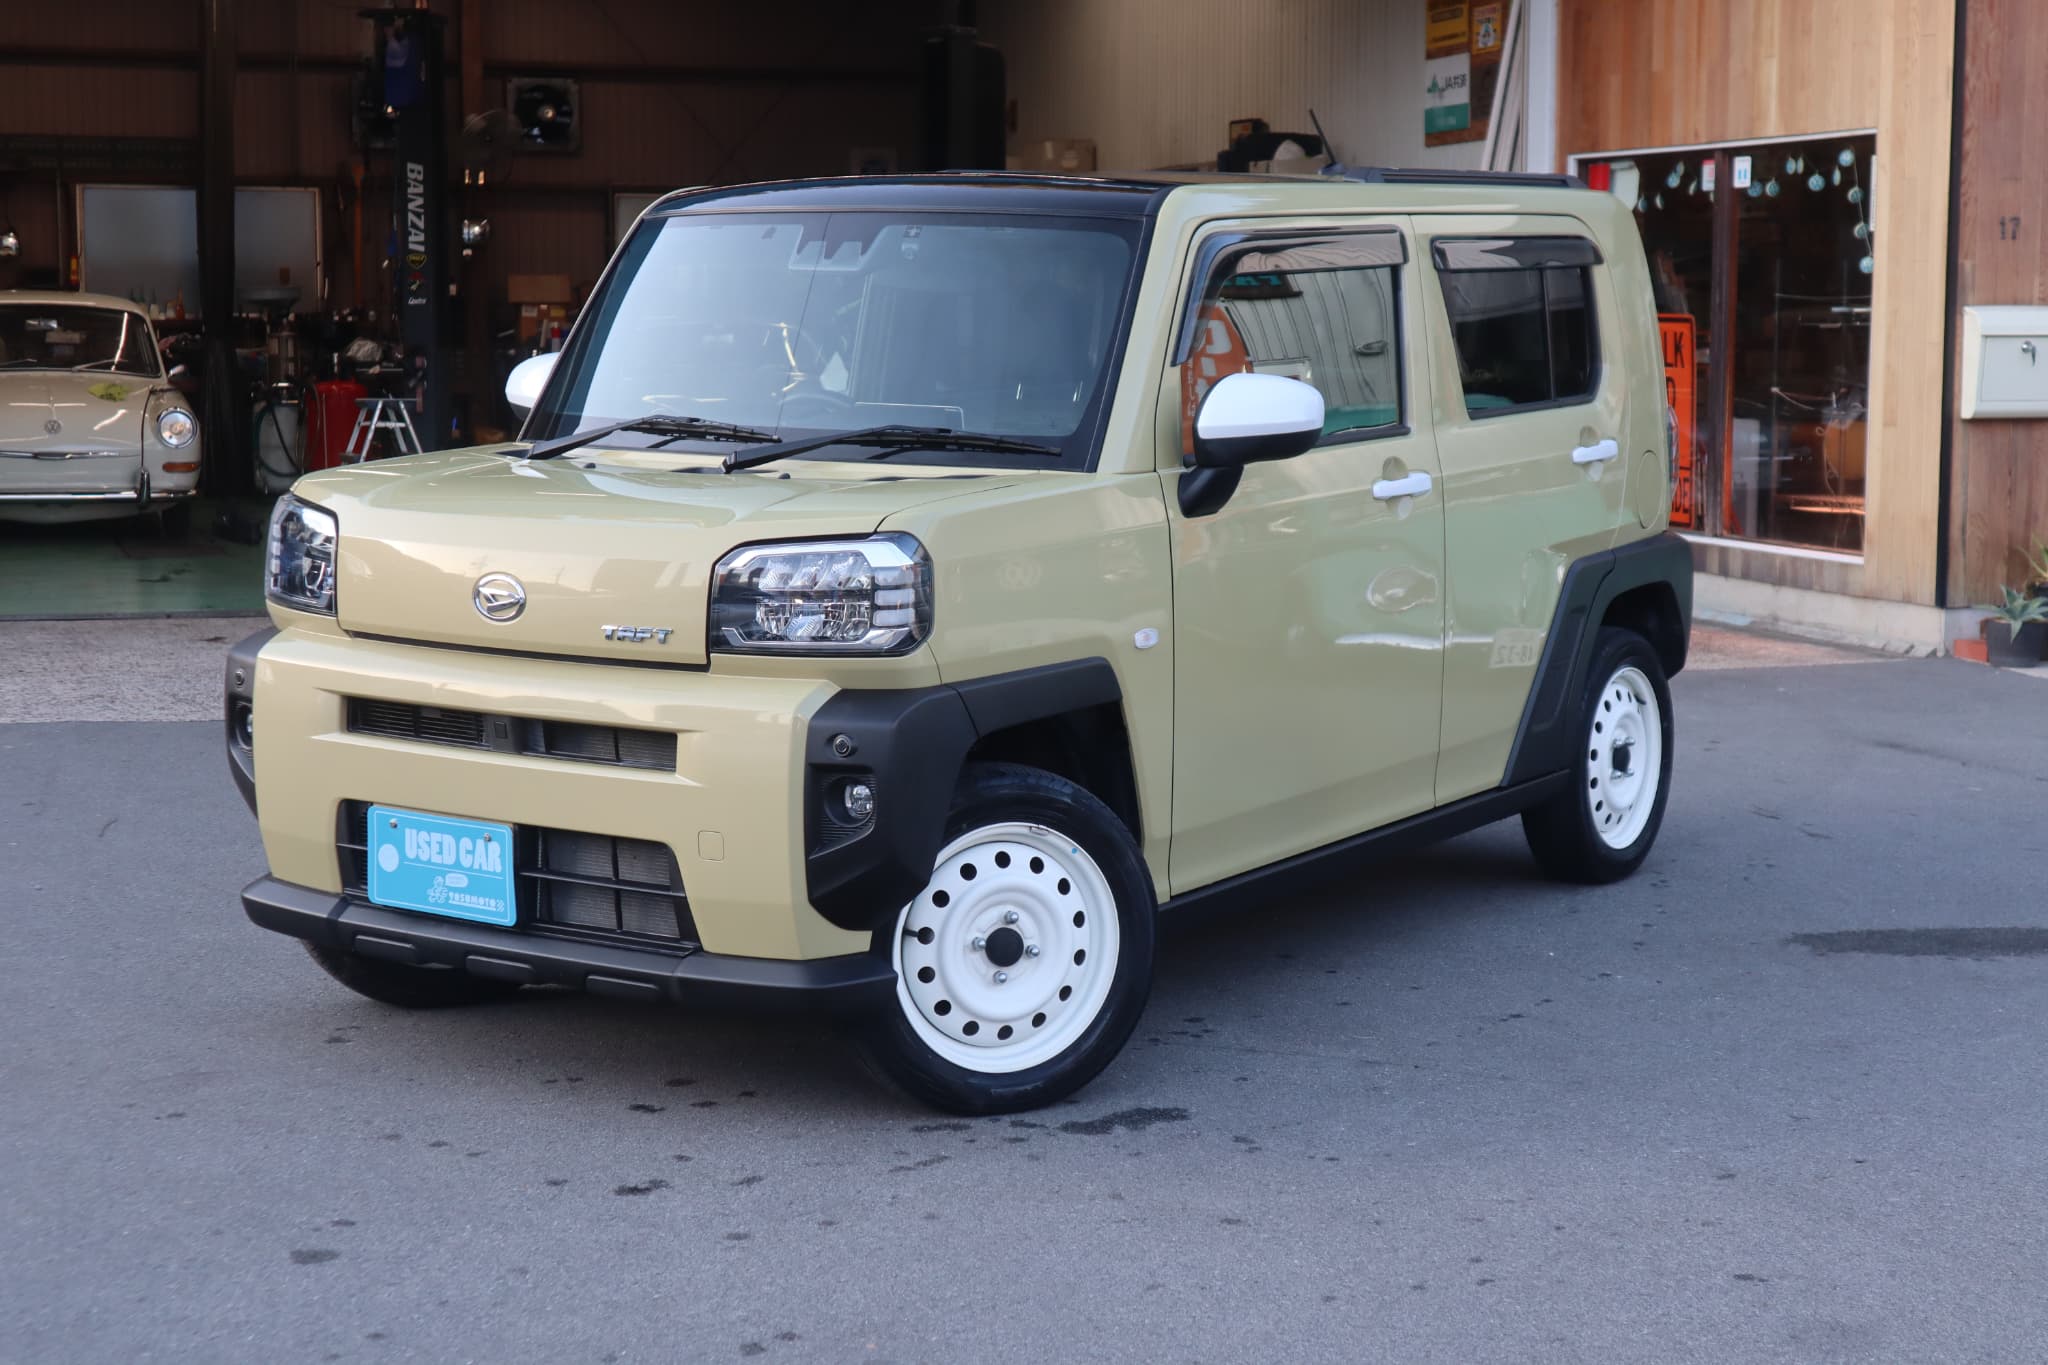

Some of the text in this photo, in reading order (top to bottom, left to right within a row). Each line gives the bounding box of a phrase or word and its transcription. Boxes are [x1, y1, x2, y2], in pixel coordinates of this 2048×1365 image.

[406, 162, 425, 252] BANZAI
[1999, 216, 2021, 241] 17
[404, 828, 502, 873] USED CAR
